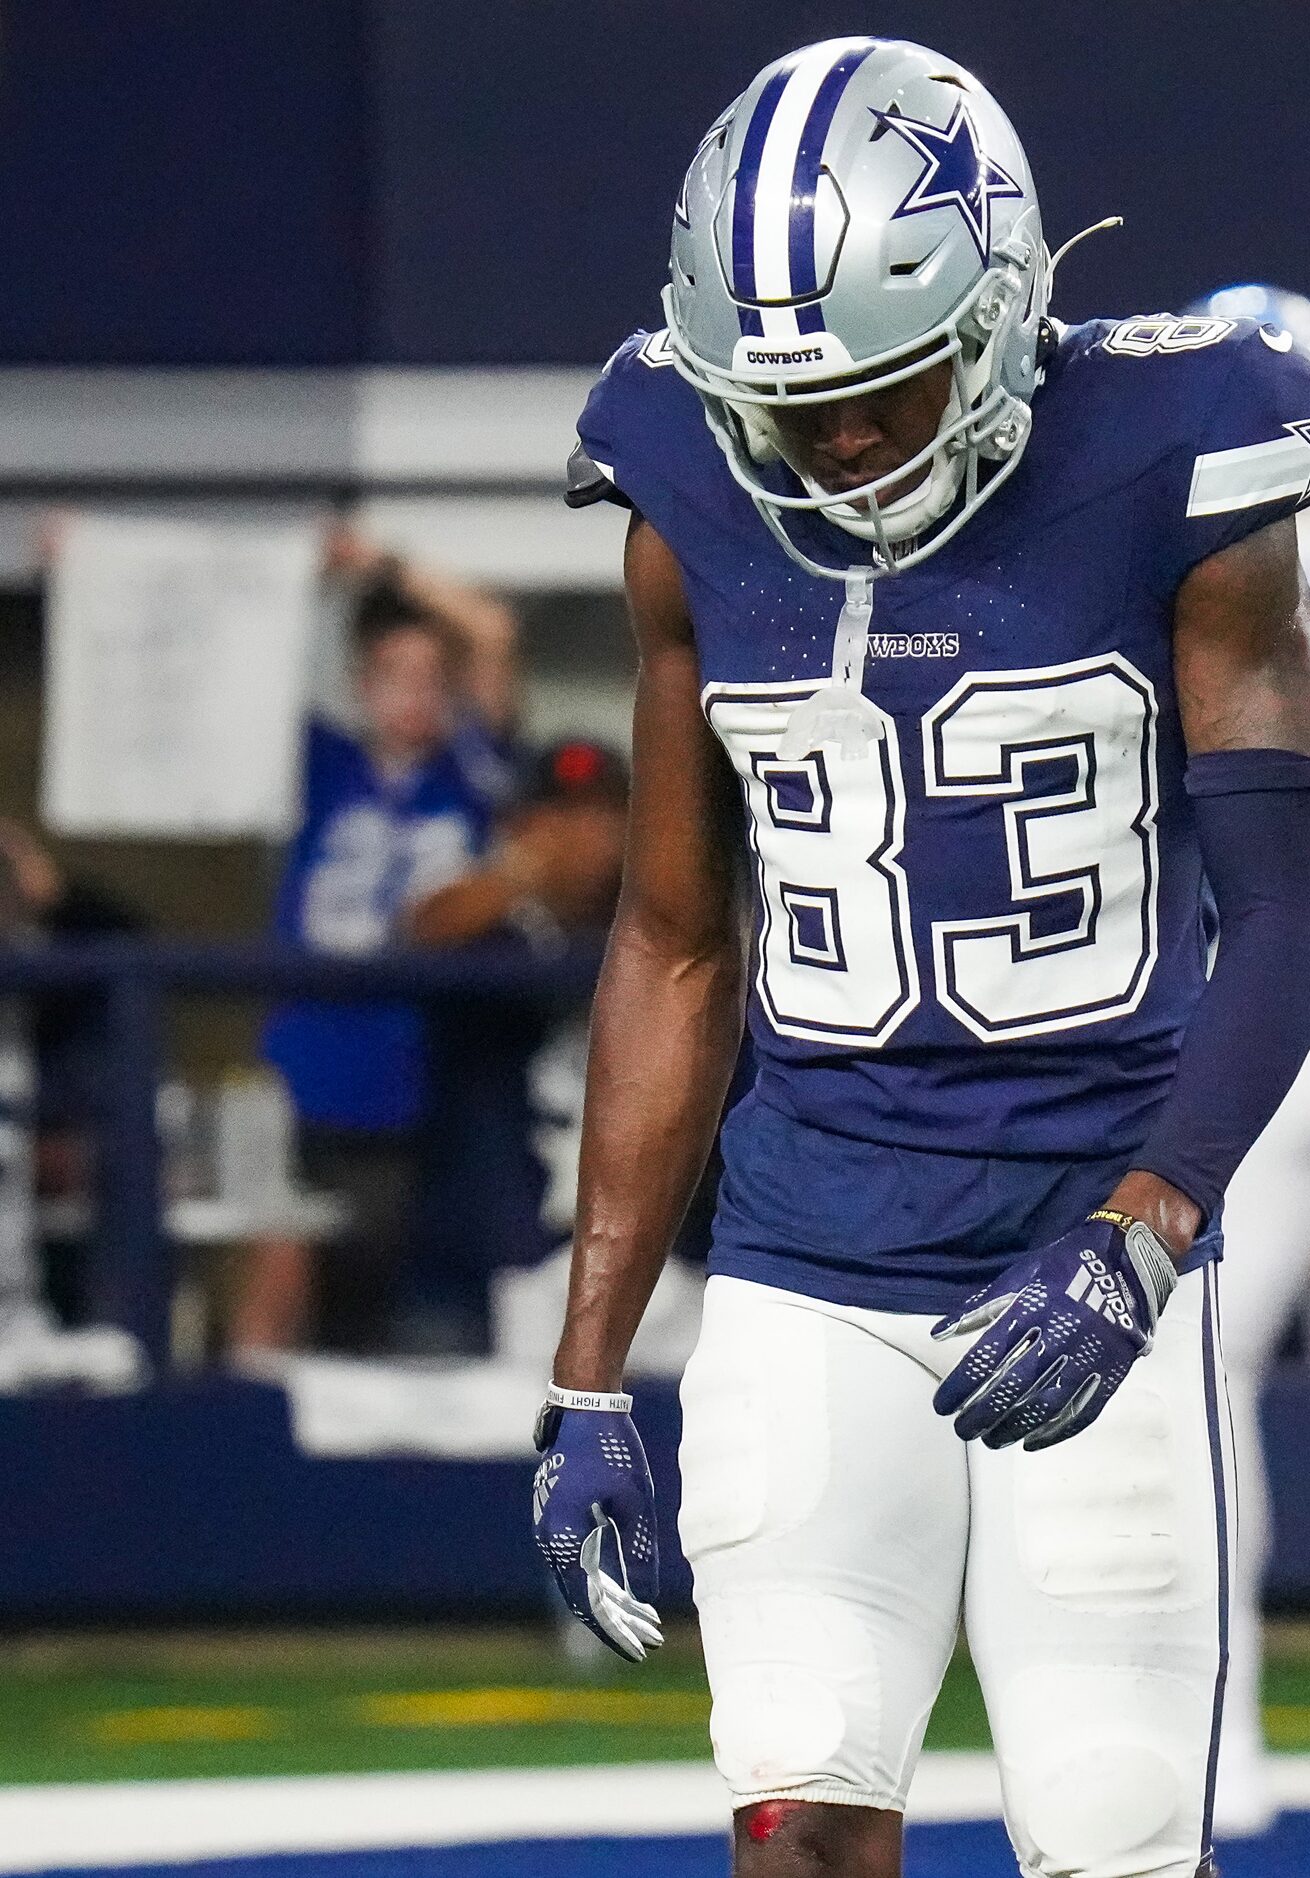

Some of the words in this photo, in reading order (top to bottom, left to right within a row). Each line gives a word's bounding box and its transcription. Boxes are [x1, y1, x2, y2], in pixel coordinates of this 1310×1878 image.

[746, 347, 825, 365] COWBOYS
[866, 632, 960, 658] WBOYS
[701, 650, 1159, 1049] 83
[1079, 1249, 1134, 1330] adidas
[571, 1396, 601, 1408] FIGHT
[609, 1398, 630, 1410] FAITH
